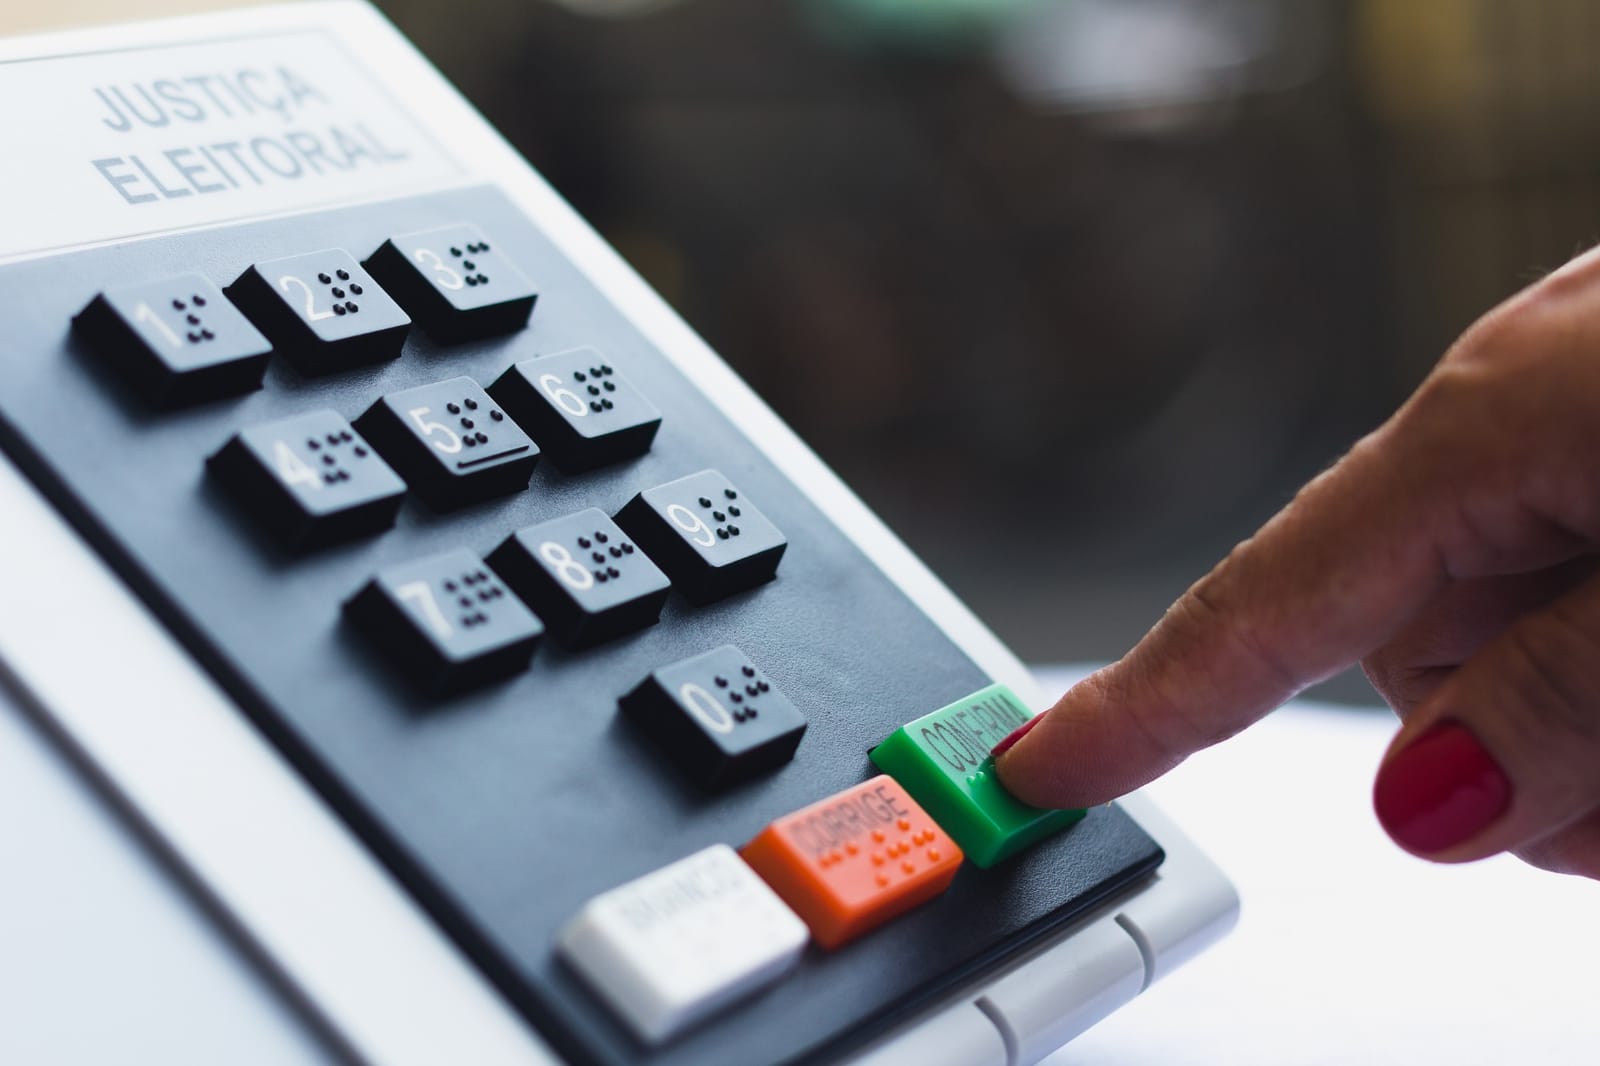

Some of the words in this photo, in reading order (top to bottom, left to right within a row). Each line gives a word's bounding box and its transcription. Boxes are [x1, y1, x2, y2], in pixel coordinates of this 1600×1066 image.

[93, 65, 328, 133] JUSTIÇA
[91, 122, 409, 205] ELEITORAL
[415, 248, 465, 291] 3
[279, 275, 336, 322] 2
[134, 303, 184, 348] 1
[539, 374, 589, 417] 6
[409, 407, 462, 454] 5
[272, 440, 323, 491] 4
[666, 504, 716, 547] 9
[539, 541, 595, 591] 8
[397, 580, 453, 641] 7
[680, 683, 735, 735] 0
